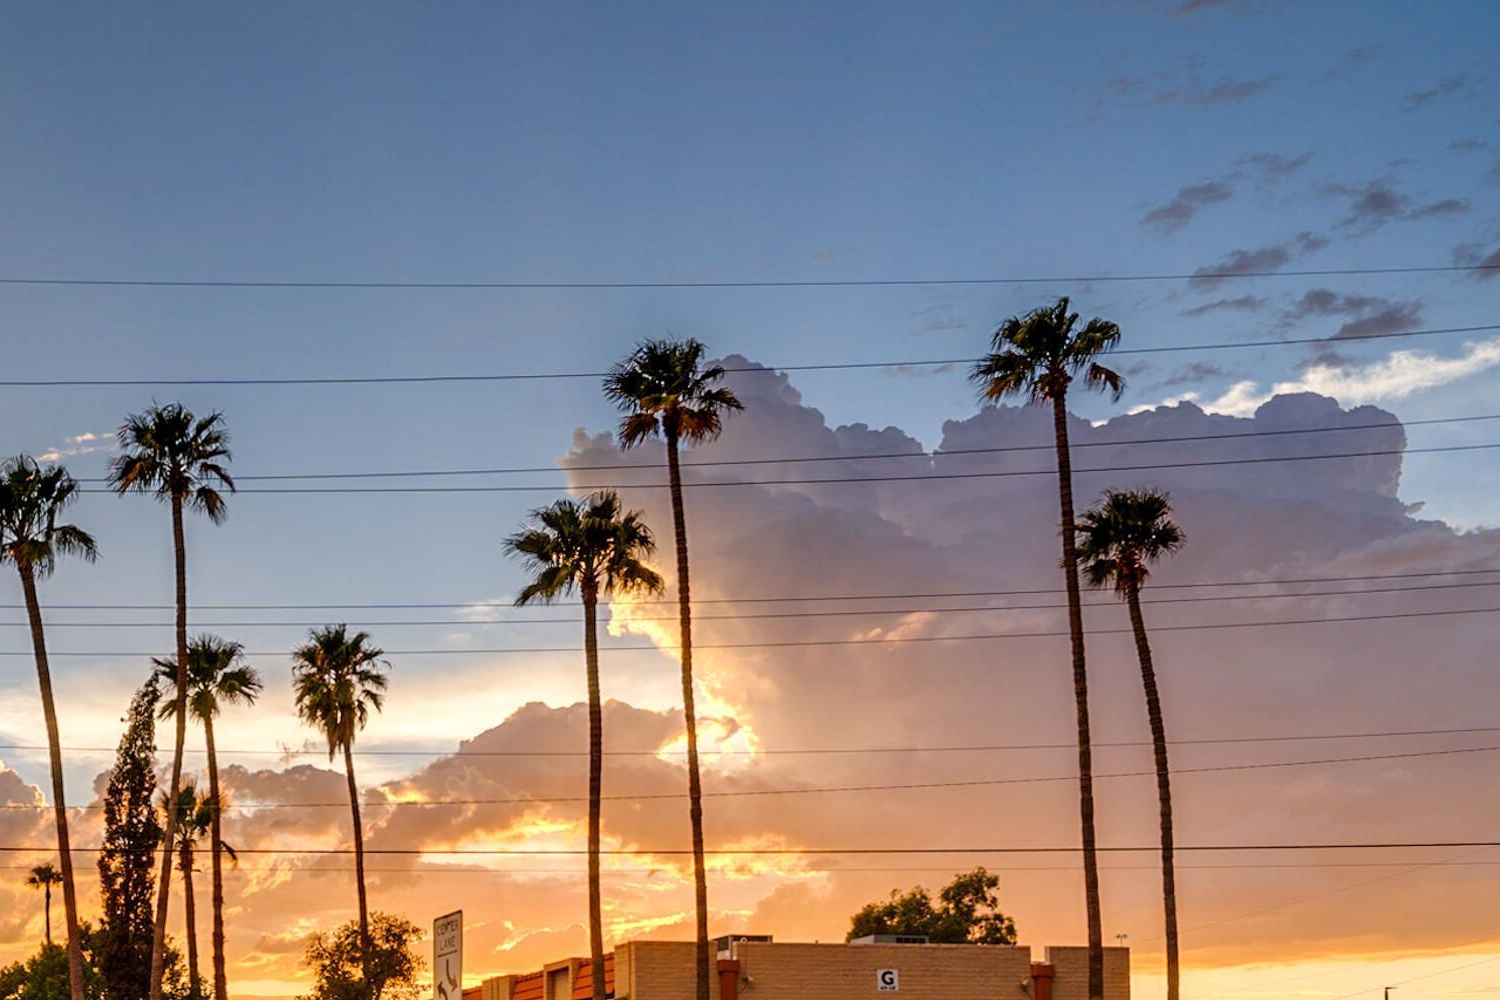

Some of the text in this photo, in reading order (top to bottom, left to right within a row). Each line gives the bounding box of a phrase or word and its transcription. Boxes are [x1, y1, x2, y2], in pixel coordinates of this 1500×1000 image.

[436, 919, 459, 937] CENTER
[440, 935, 456, 951] LANE
[881, 970, 894, 986] G
